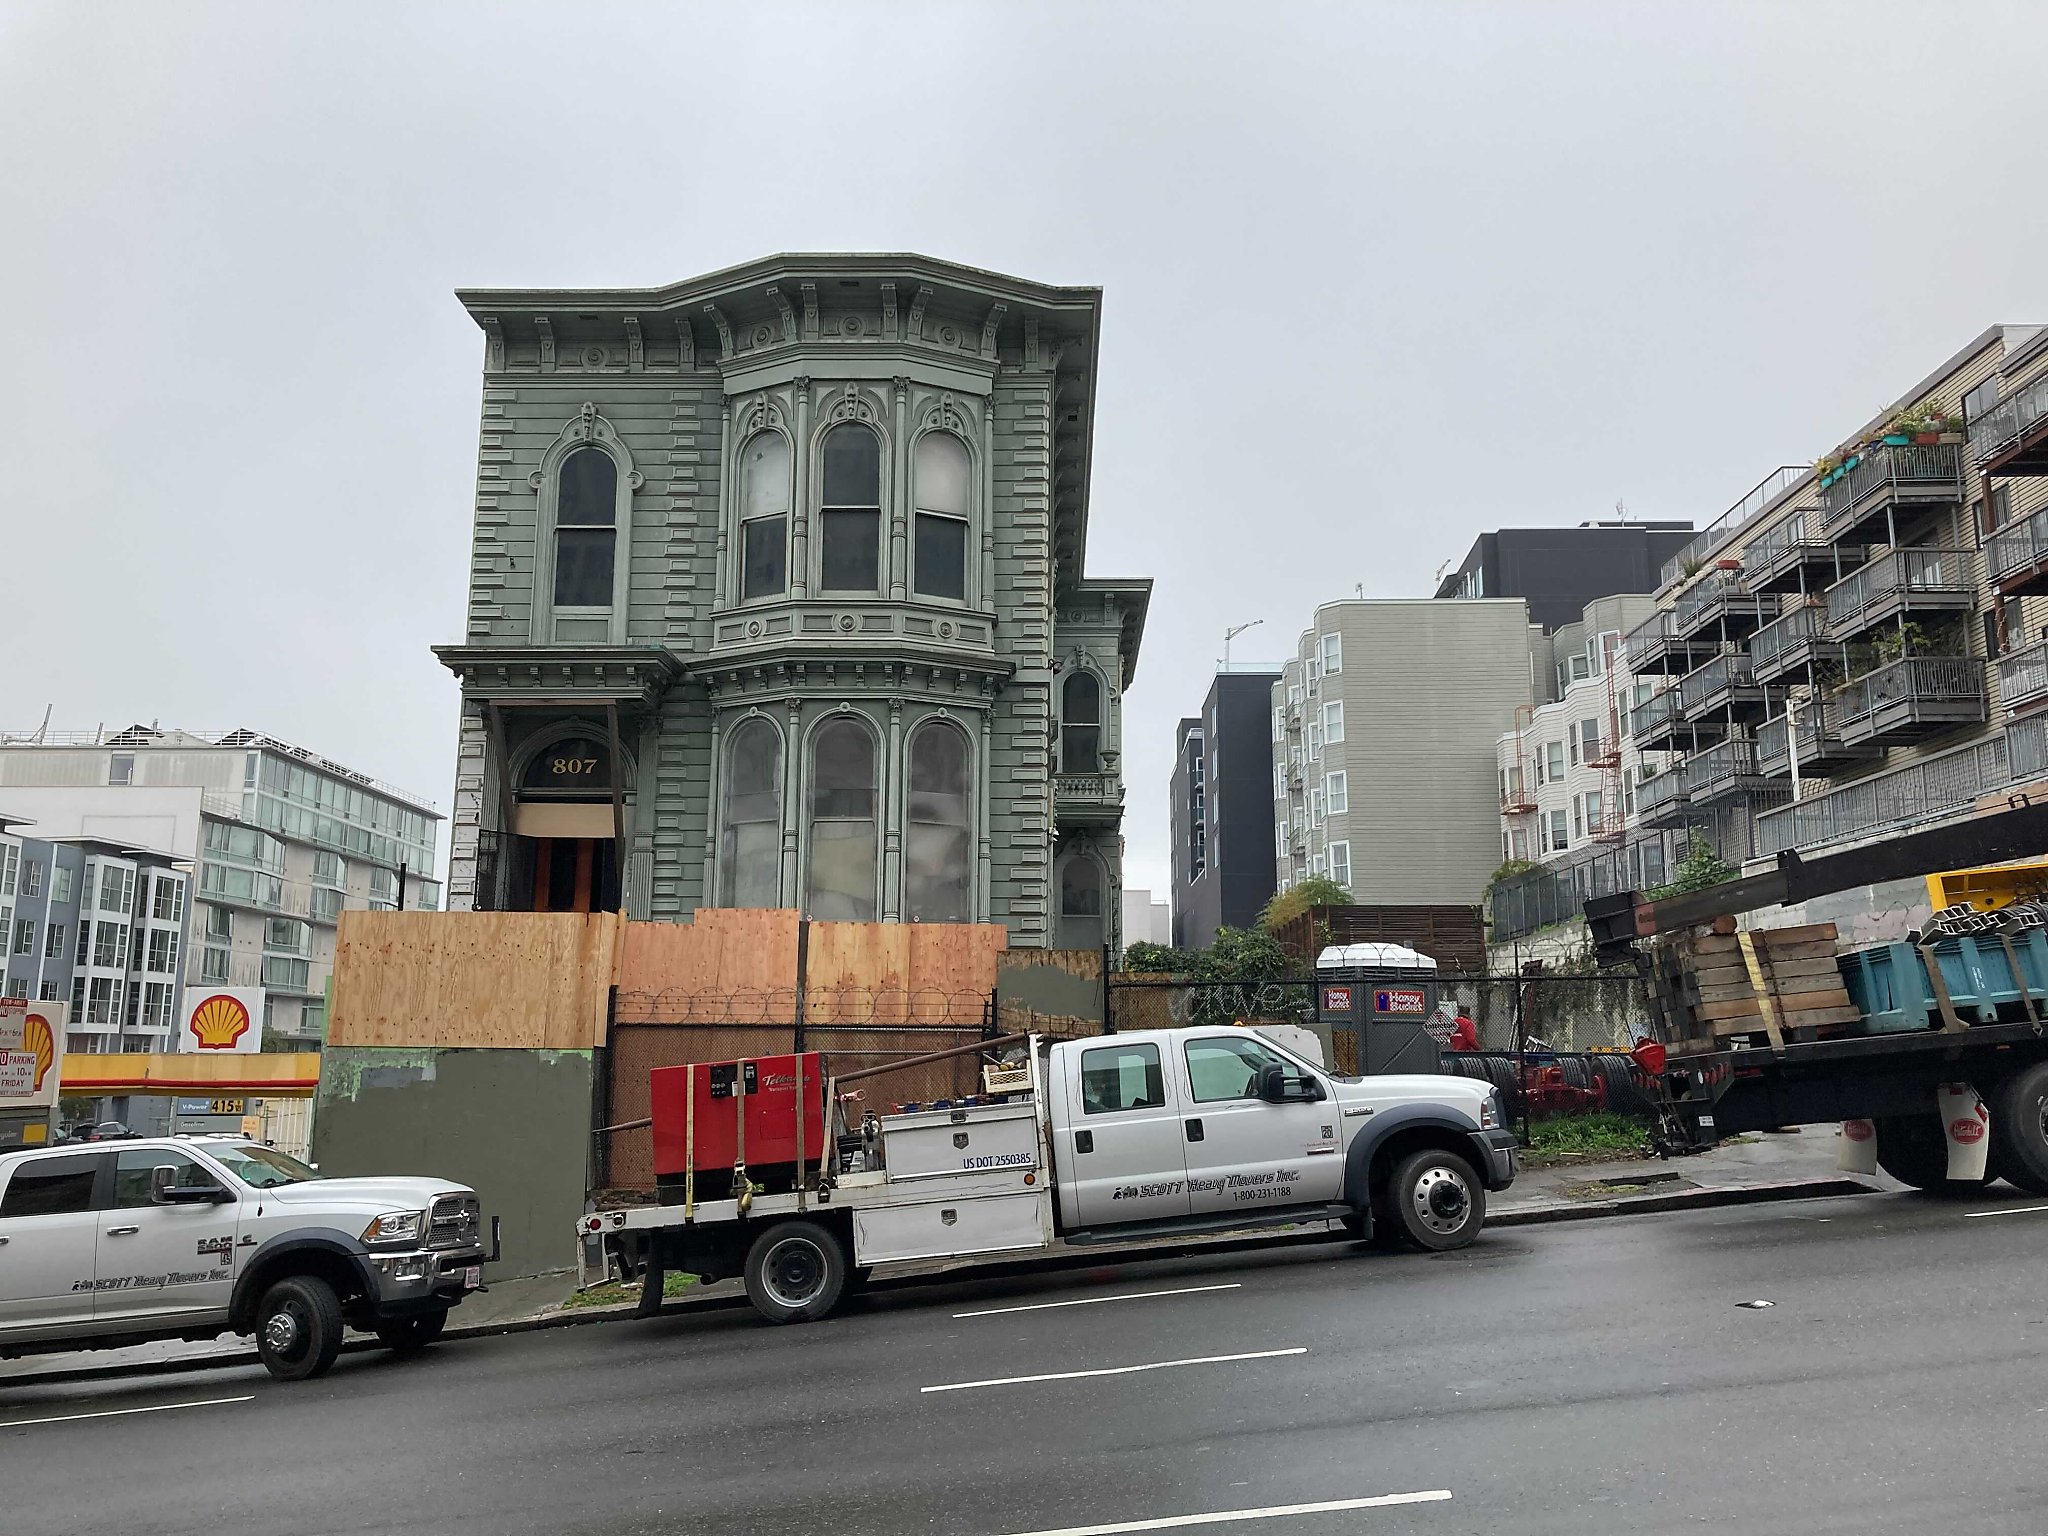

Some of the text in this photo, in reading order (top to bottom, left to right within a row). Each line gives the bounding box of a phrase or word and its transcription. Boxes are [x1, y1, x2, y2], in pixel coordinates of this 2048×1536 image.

[552, 758, 598, 774] 807
[1389, 992, 1421, 1003] Honey
[9, 1055, 35, 1065] PARKING
[1, 1079, 25, 1087] FRIDAY
[963, 1153, 1031, 1169] US DOT 2550385
[1140, 1169, 1301, 1198] SCOTT Heavy Movers Inc.
[1233, 1186, 1292, 1201] 1-800-231-1188
[94, 1276, 132, 1290] SCOTT
